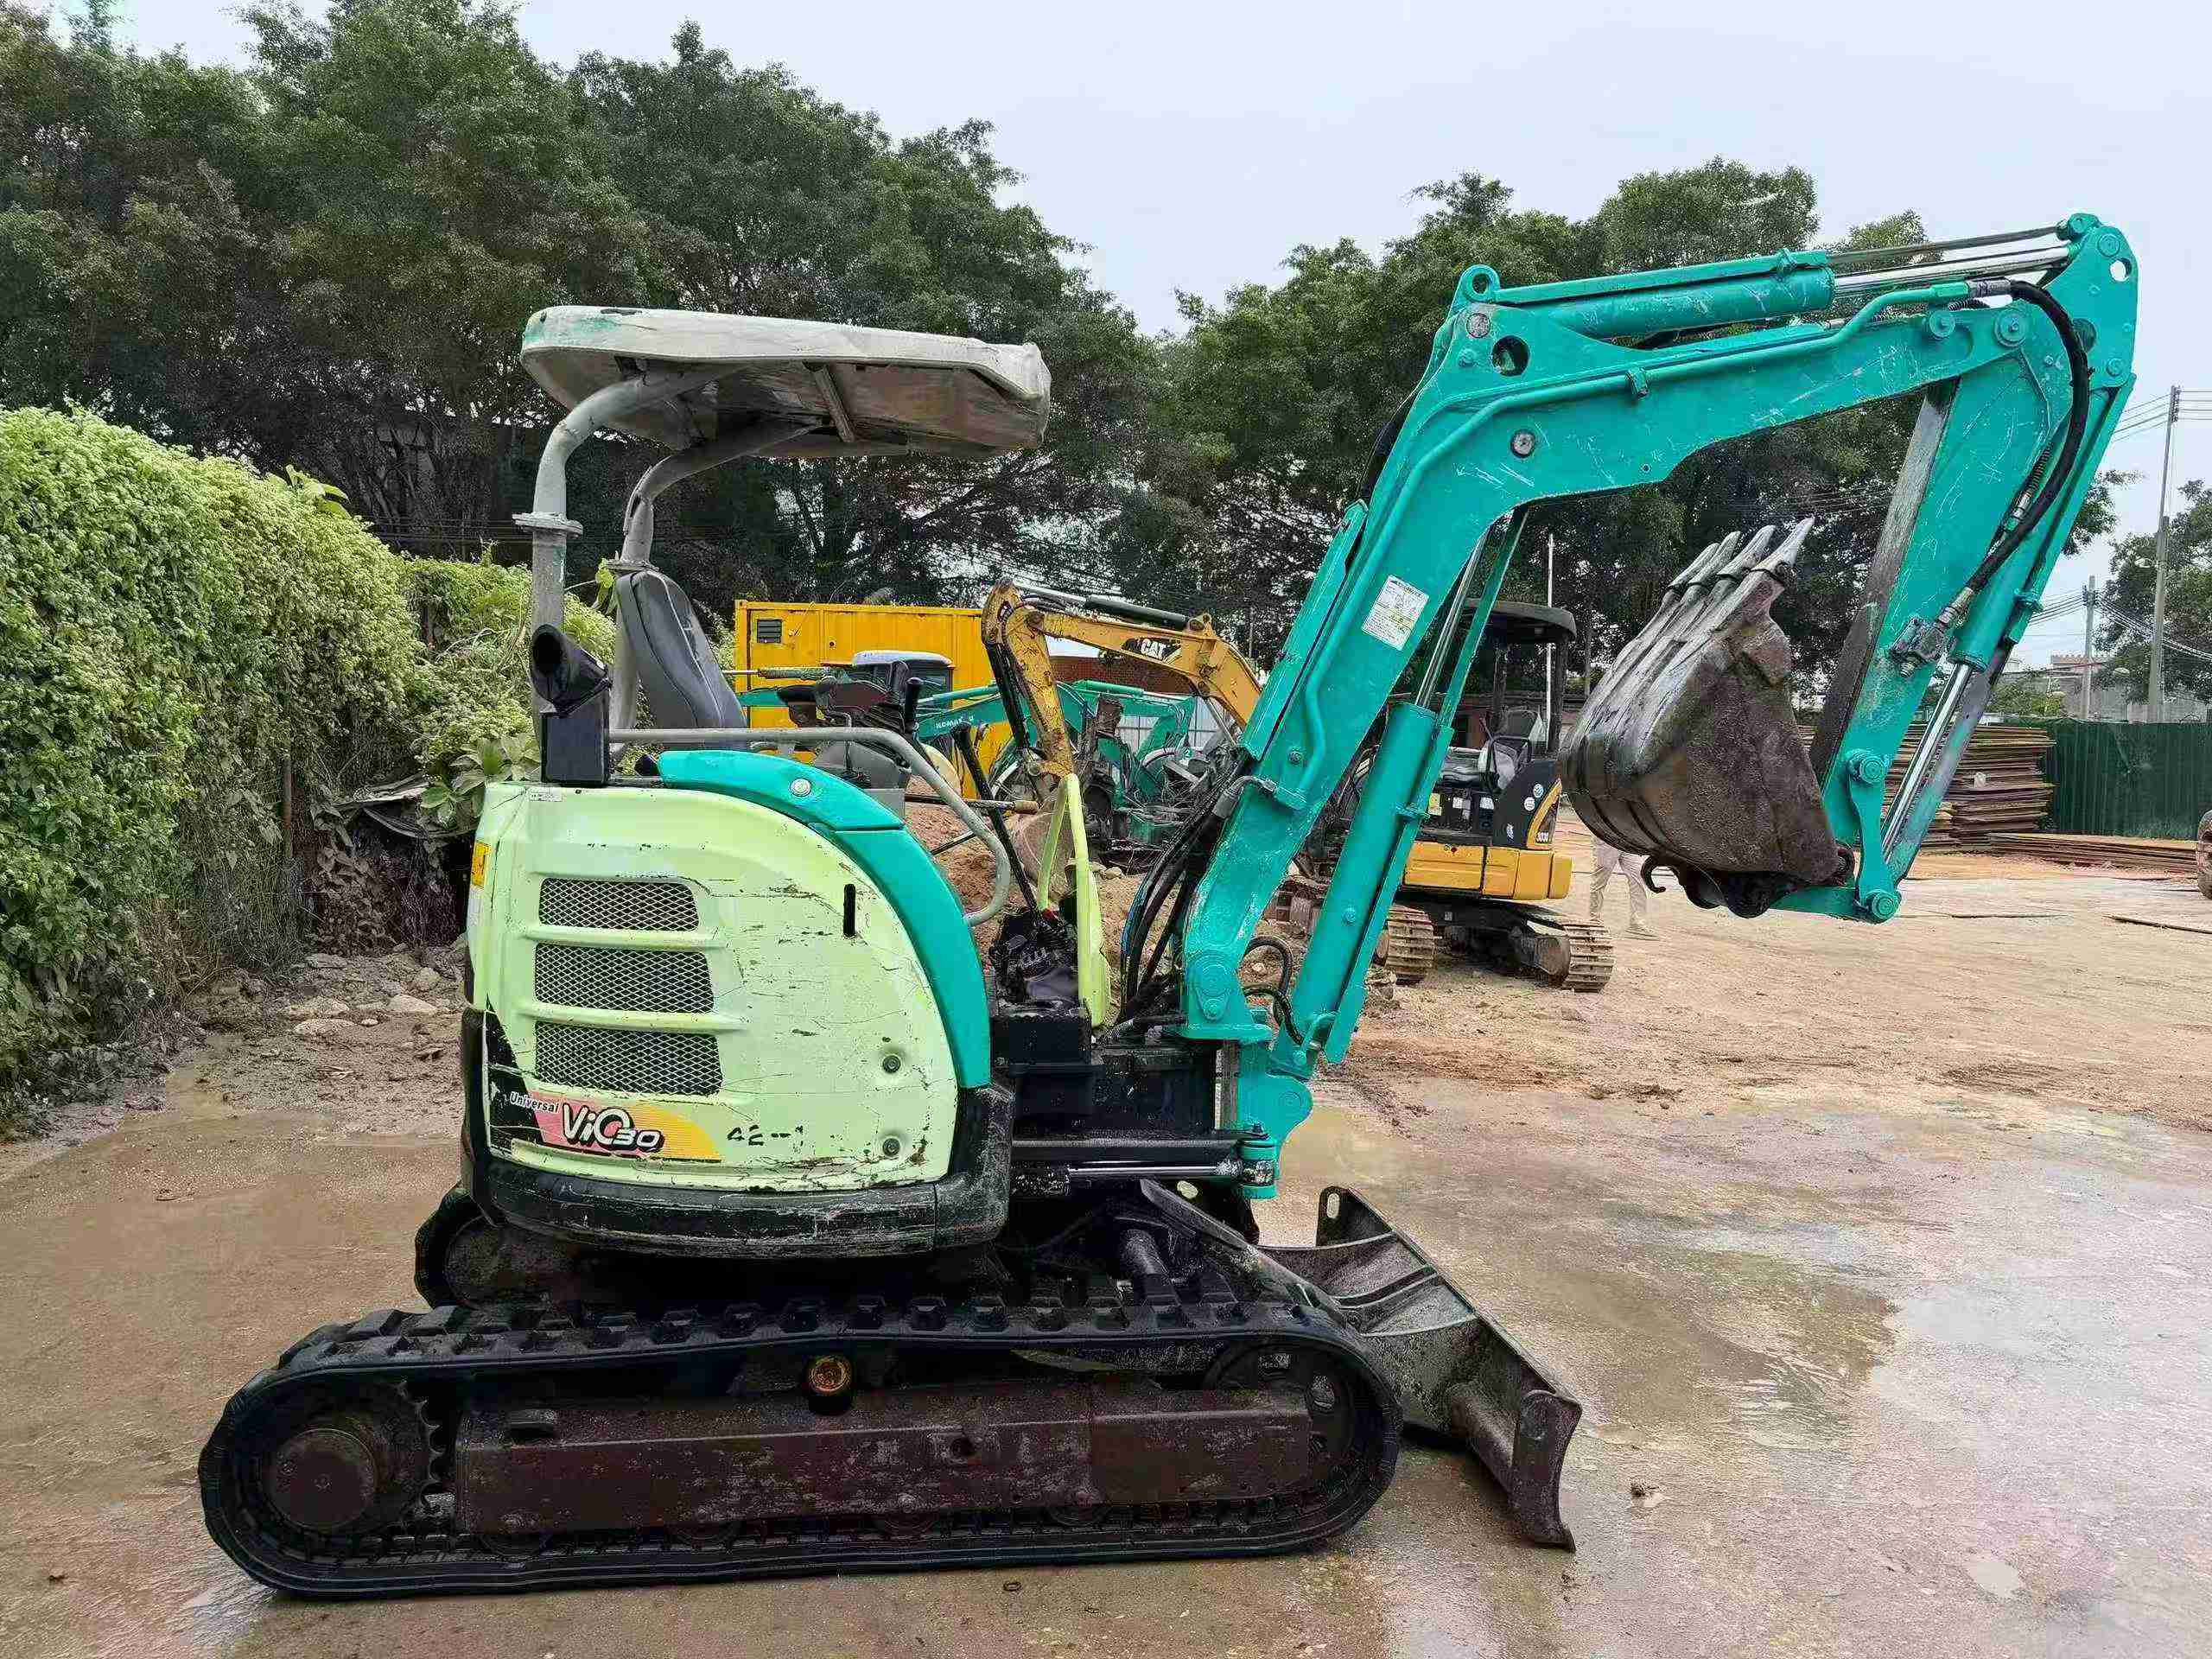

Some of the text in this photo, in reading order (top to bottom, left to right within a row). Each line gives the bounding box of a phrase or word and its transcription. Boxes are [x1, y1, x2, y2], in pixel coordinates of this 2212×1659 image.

[1141, 639, 1166, 659] CAT
[935, 715, 975, 728] KOMATU
[510, 1091, 559, 1113] Universal
